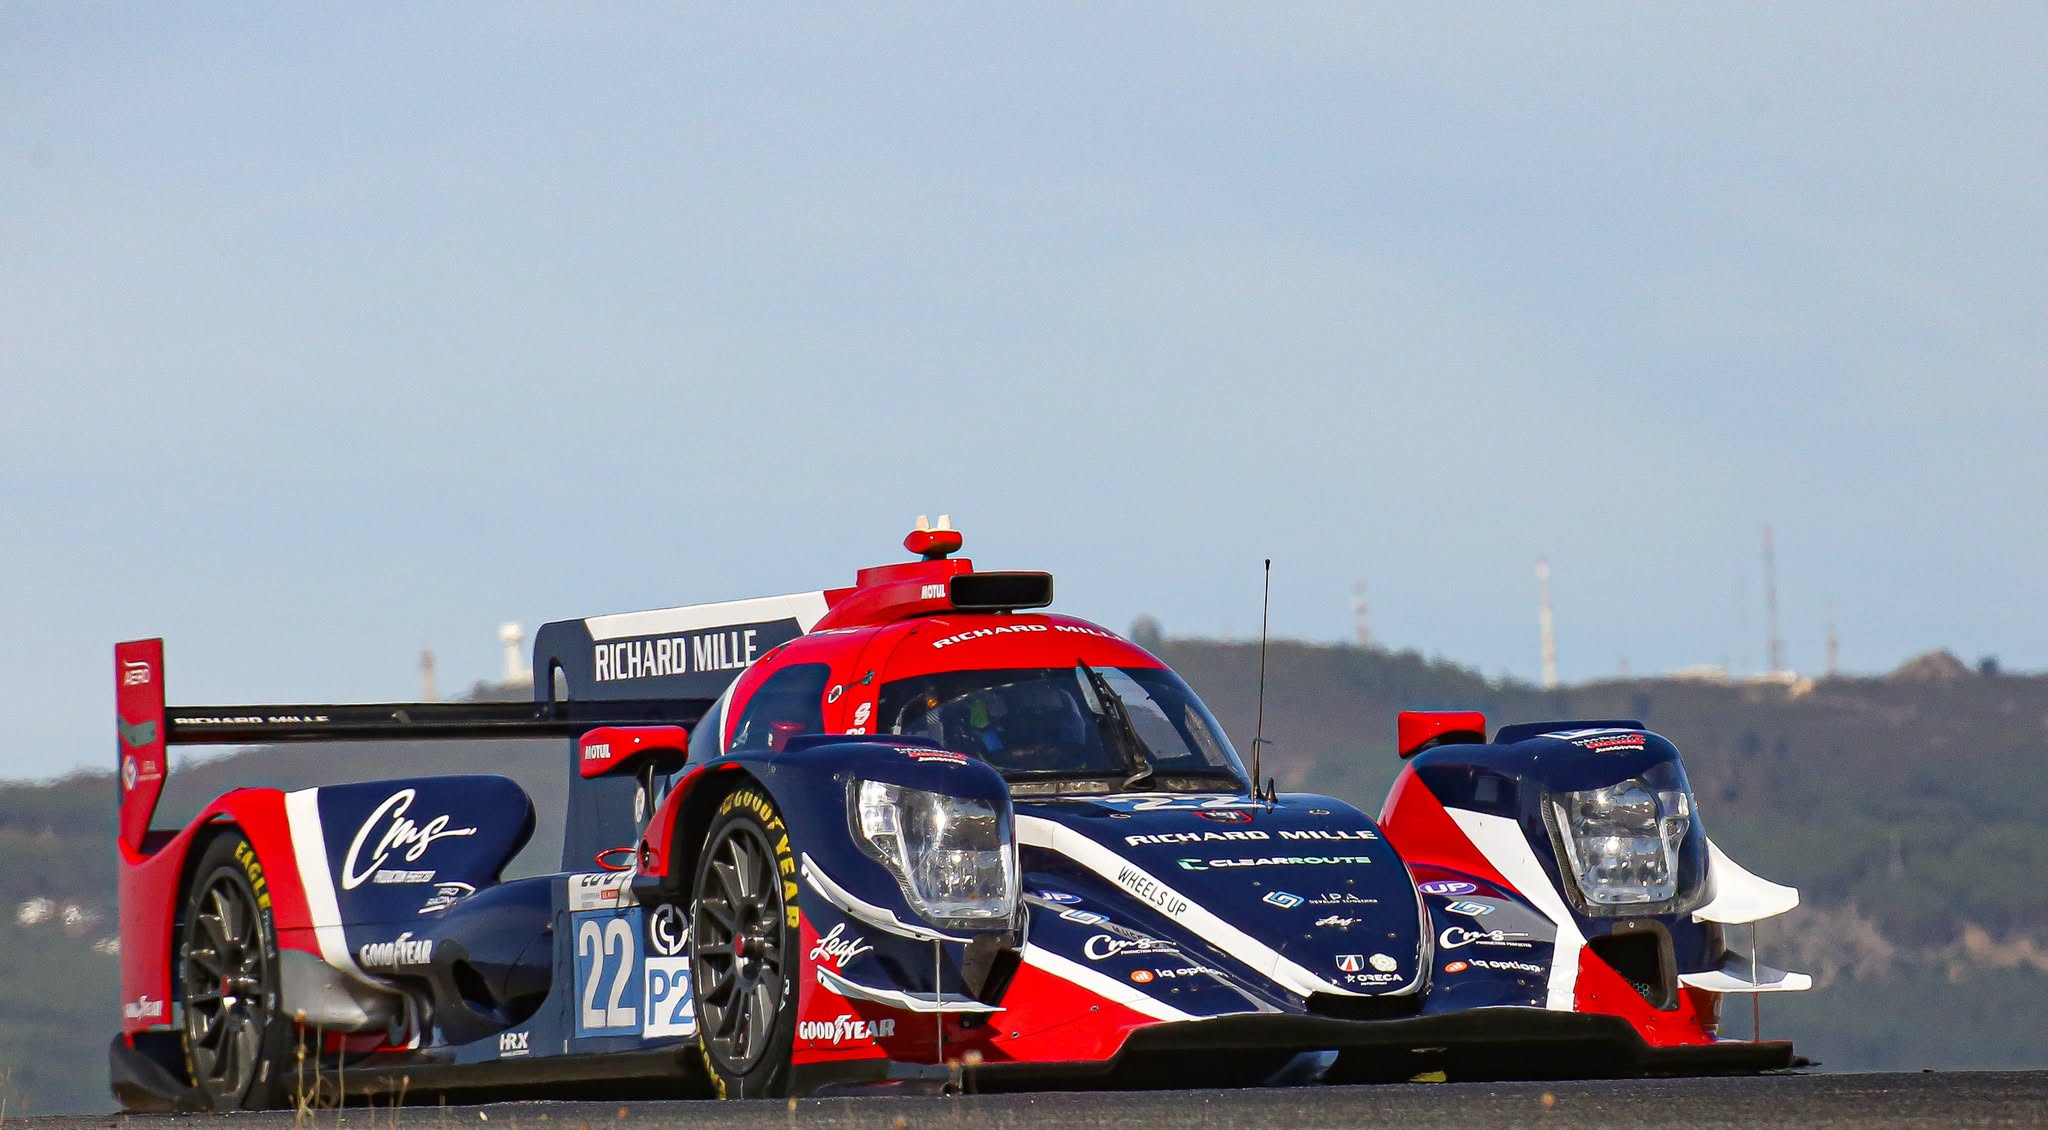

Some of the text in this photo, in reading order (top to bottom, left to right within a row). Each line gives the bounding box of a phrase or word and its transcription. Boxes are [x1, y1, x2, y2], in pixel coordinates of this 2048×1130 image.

[921, 584, 946, 600] MOTUL
[932, 624, 1047, 648] RICHARD
[595, 630, 757, 681] RICHARD MILLE
[585, 744, 611, 759] MOTUL
[1104, 792, 1267, 810] 22
[342, 788, 477, 890] Cms
[1125, 830, 1379, 847] RICHARD MILLE
[1209, 856, 1371, 868] CLEARROUTE
[234, 841, 272, 910] EAGLE
[1118, 866, 1188, 916] WHEELS UP
[1425, 882, 1468, 893] UP
[360, 931, 433, 969] GOODYEAR
[579, 918, 636, 1029] 22
[1489, 960, 1541, 973] option
[1357, 973, 1403, 982] ORECA
[649, 969, 696, 1025] P2
[500, 1031, 529, 1050] HRX
[799, 1014, 896, 1046] GOODYEAR
